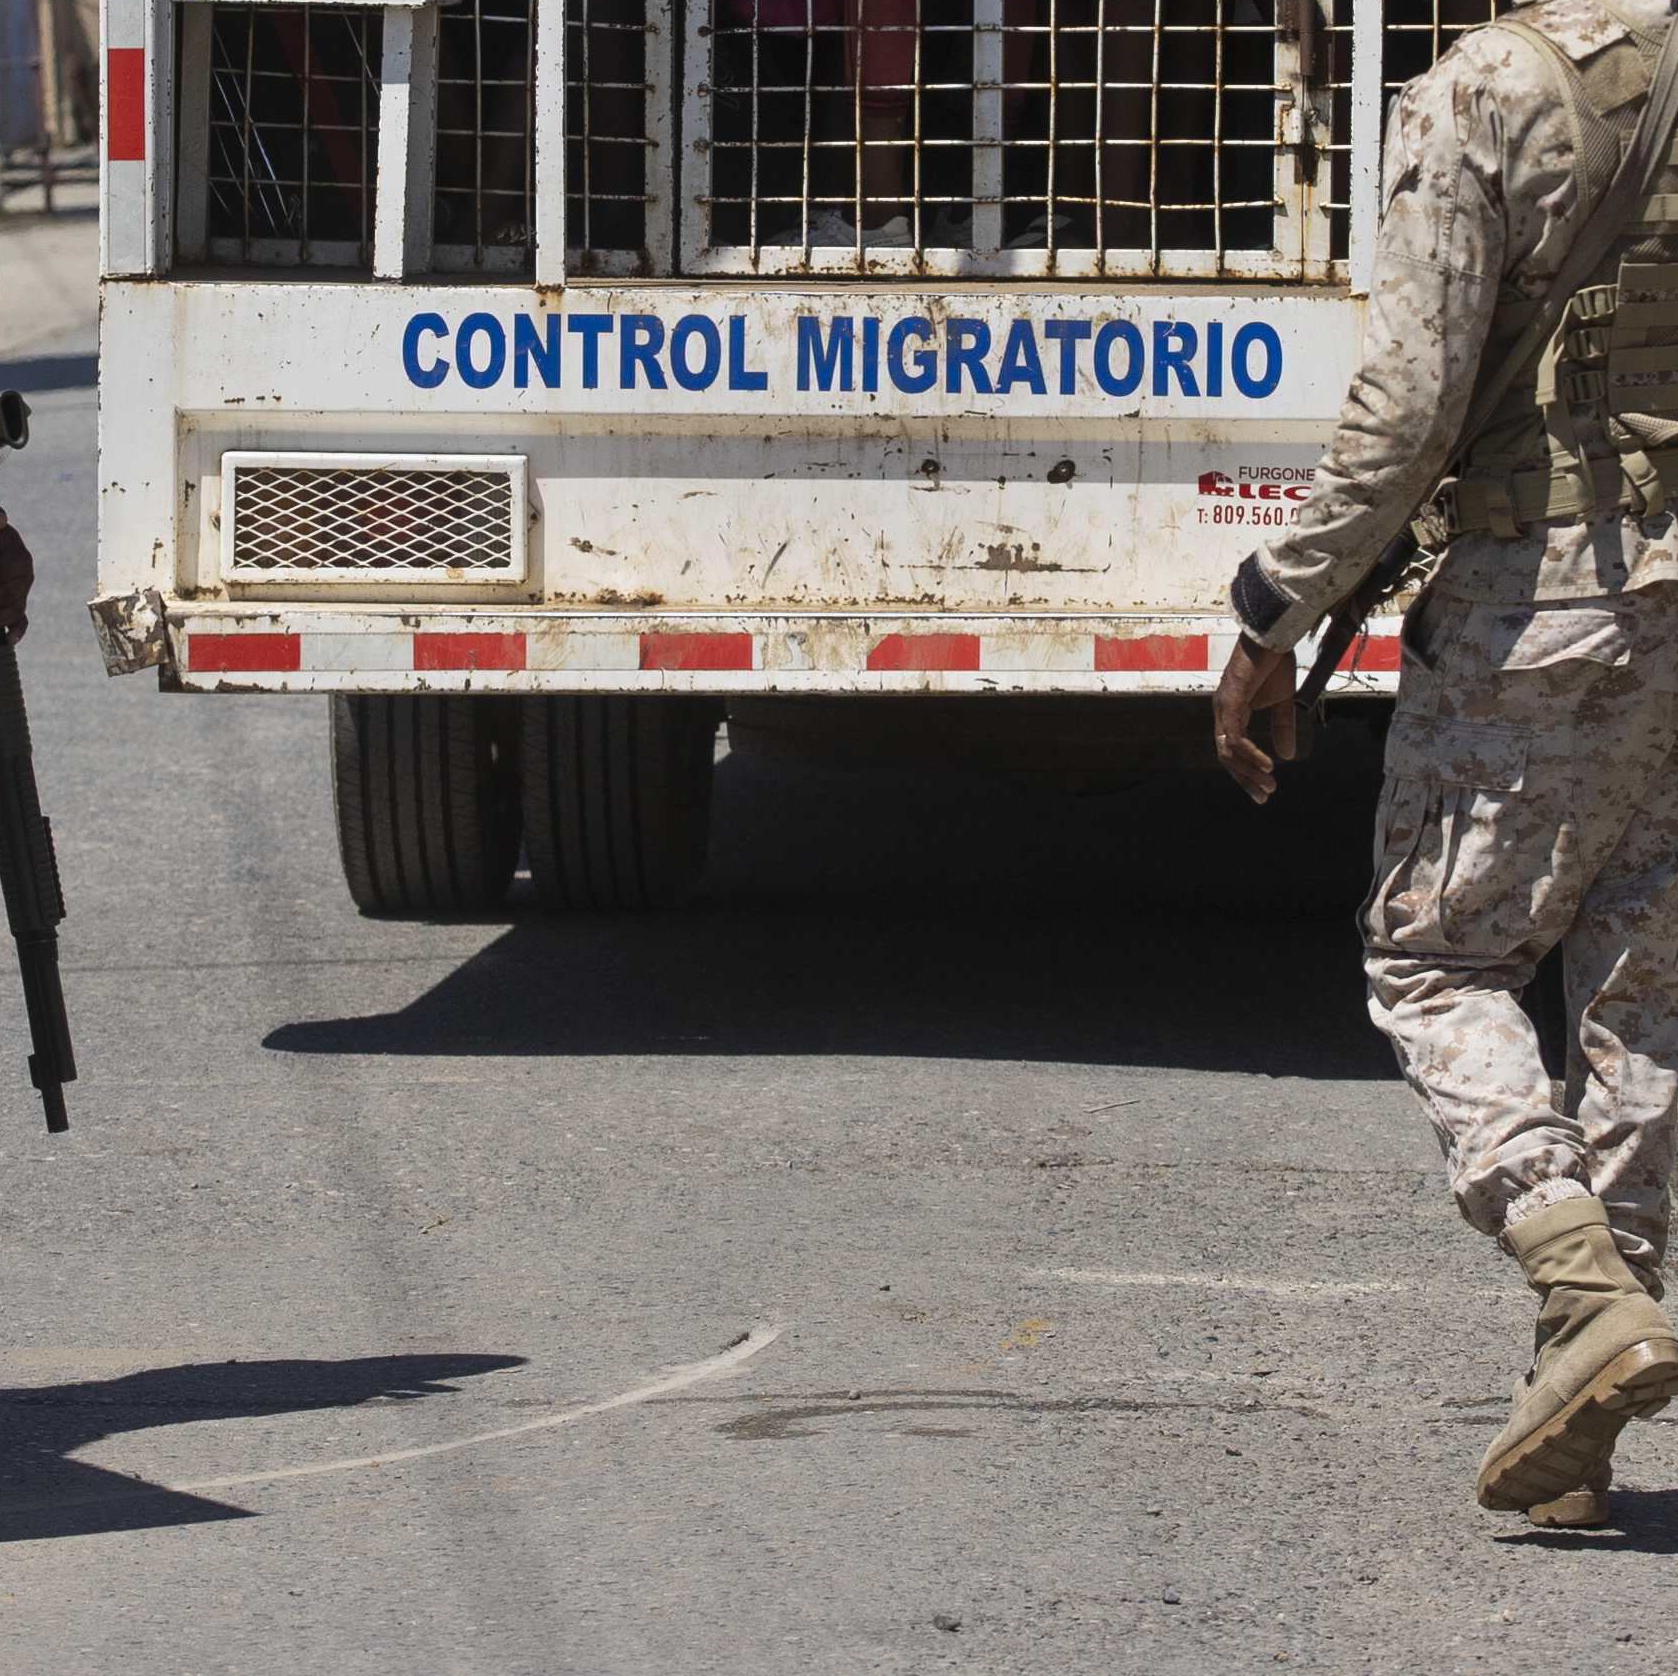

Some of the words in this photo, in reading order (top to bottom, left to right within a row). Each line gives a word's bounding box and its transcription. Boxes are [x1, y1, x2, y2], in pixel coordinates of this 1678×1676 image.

[402, 312, 768, 391] CONTROL
[796, 315, 1283, 398] MIGRATORIO
[1238, 466, 1315, 481] FURGONE
[1239, 483, 1312, 501] LEC
[1197, 508, 1208, 524] T:
[1213, 505, 1298, 526] 809.560.
